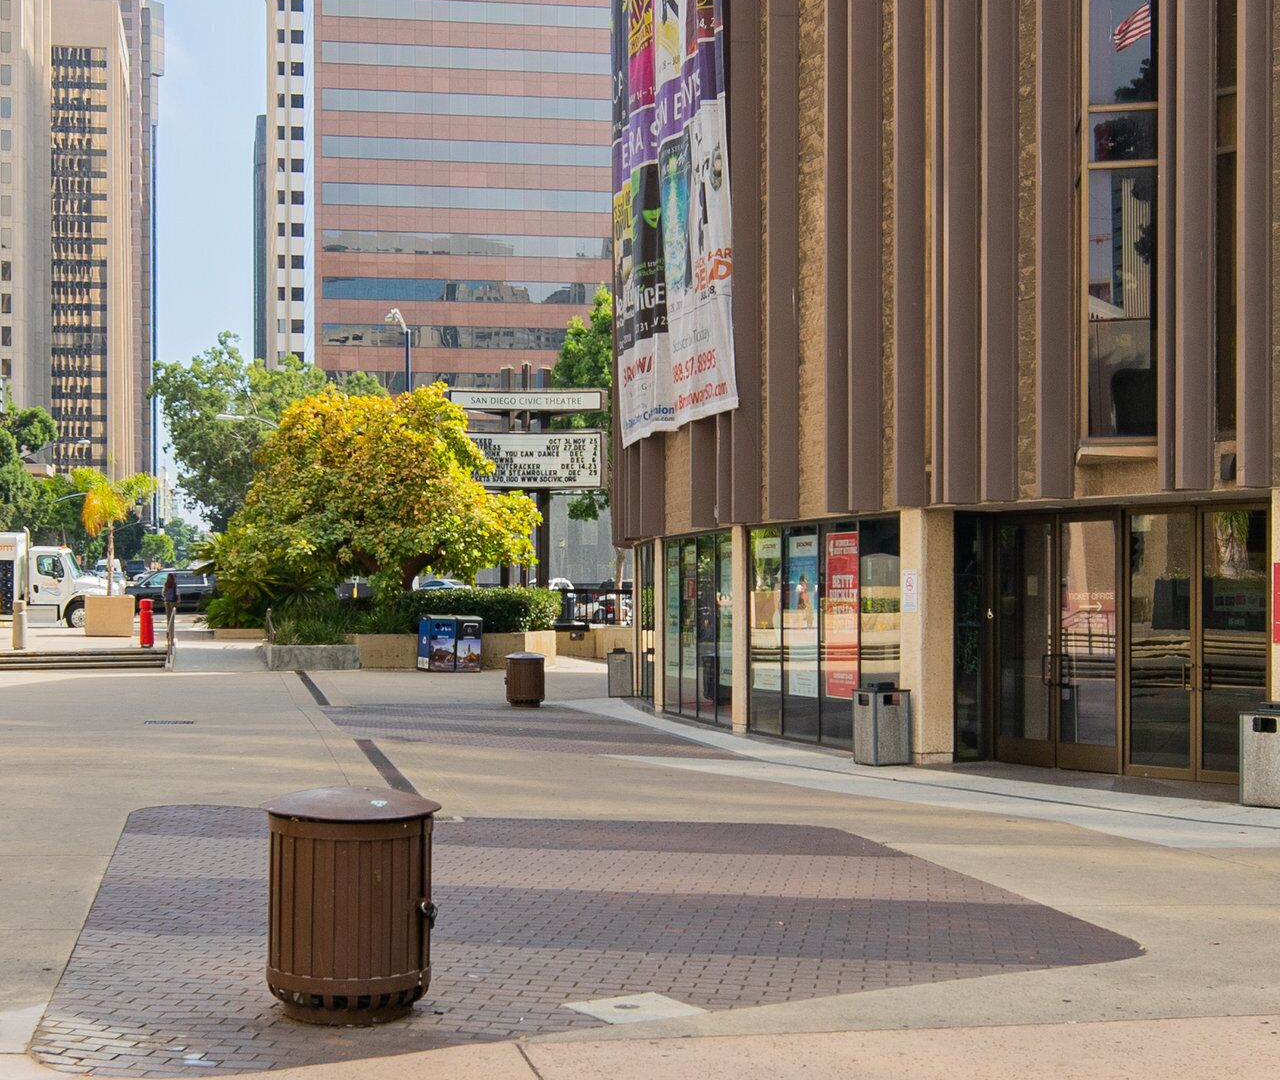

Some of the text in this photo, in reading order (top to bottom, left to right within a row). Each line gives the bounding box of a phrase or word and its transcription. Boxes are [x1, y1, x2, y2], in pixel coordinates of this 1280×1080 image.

[470, 396, 488, 404] SAN
[490, 397, 516, 405] DIEGO
[545, 397, 582, 405] THEATRE
[1068, 591, 1114, 600] TICKET OFFICE
